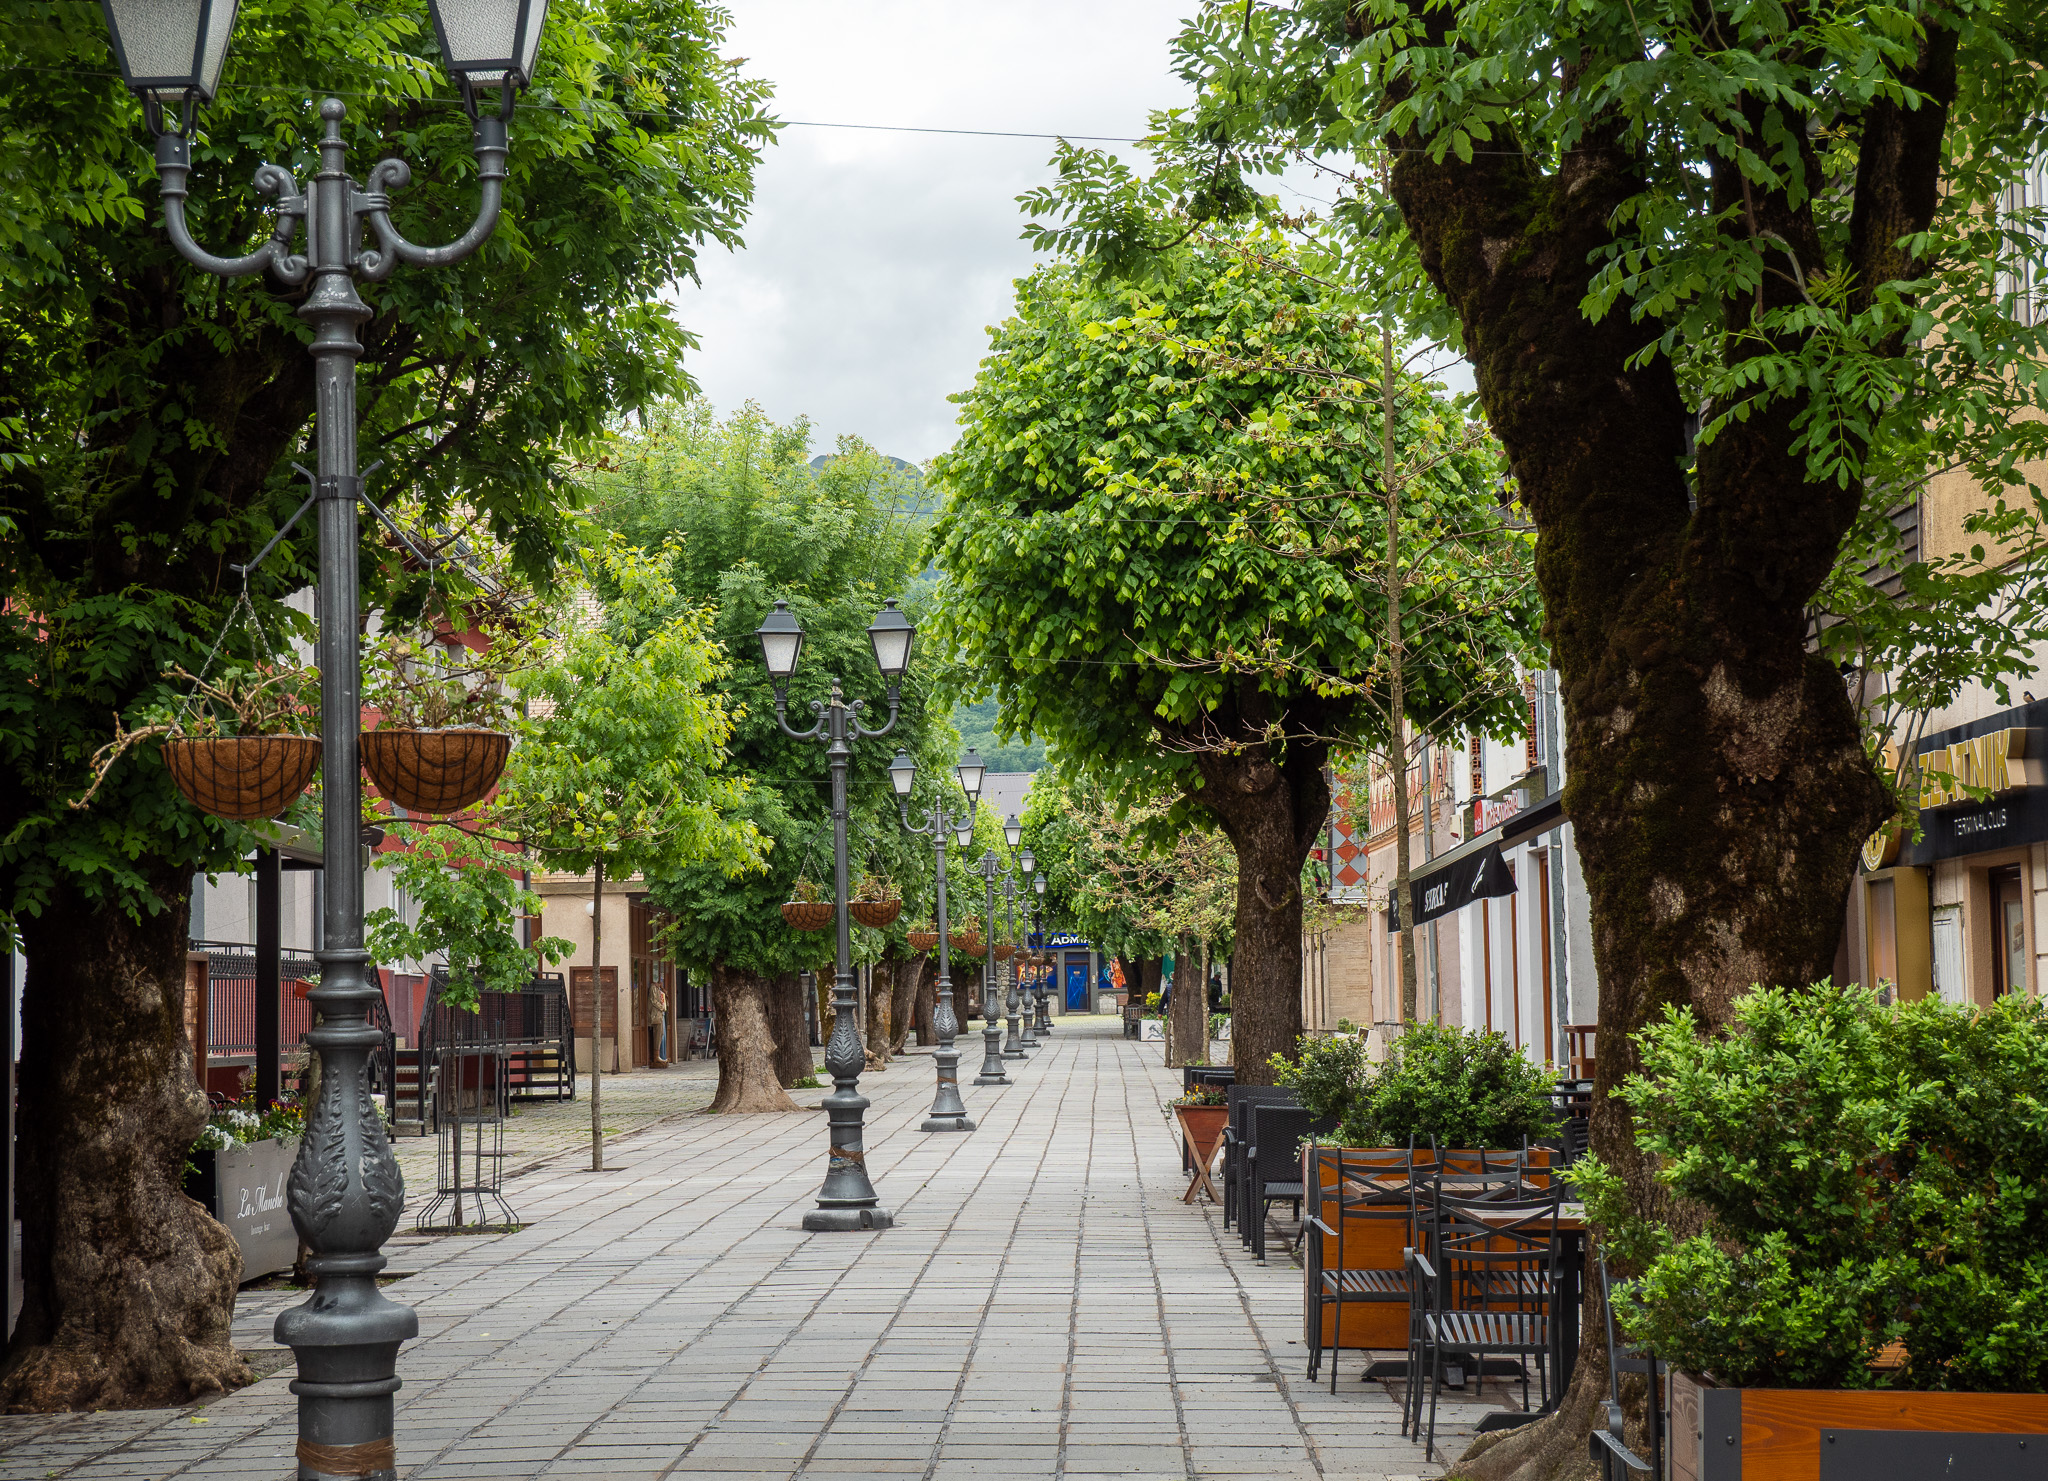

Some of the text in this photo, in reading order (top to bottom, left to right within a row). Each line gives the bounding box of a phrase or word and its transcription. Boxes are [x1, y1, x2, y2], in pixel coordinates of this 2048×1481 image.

[1918, 727, 2011, 811] ZLATNIK
[1953, 808, 2007, 837] TERMINAL CLUB
[237, 1171, 283, 1219] La Manche
